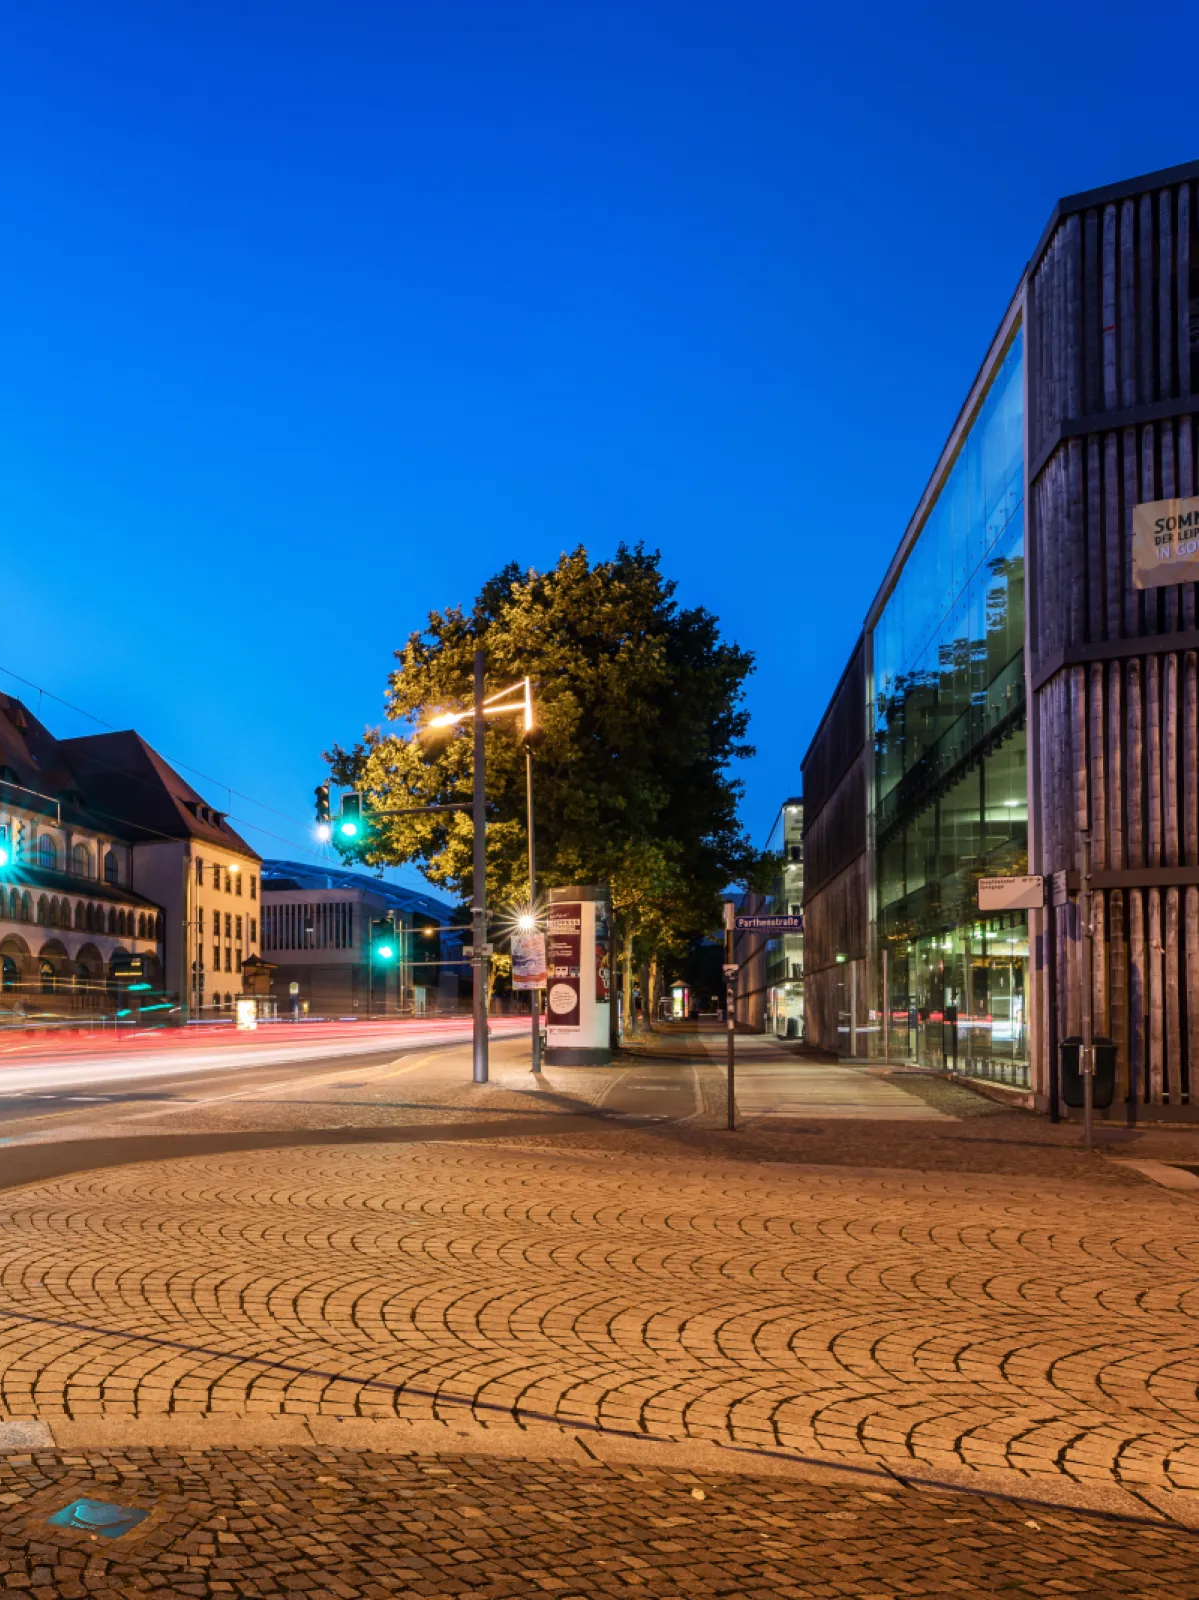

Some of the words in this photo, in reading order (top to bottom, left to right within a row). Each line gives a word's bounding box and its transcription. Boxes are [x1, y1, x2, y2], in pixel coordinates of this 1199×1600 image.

[1155, 533, 1173, 546] DER
[1156, 546, 1170, 560] IN
[738, 917, 798, 928] Parthenstraße
